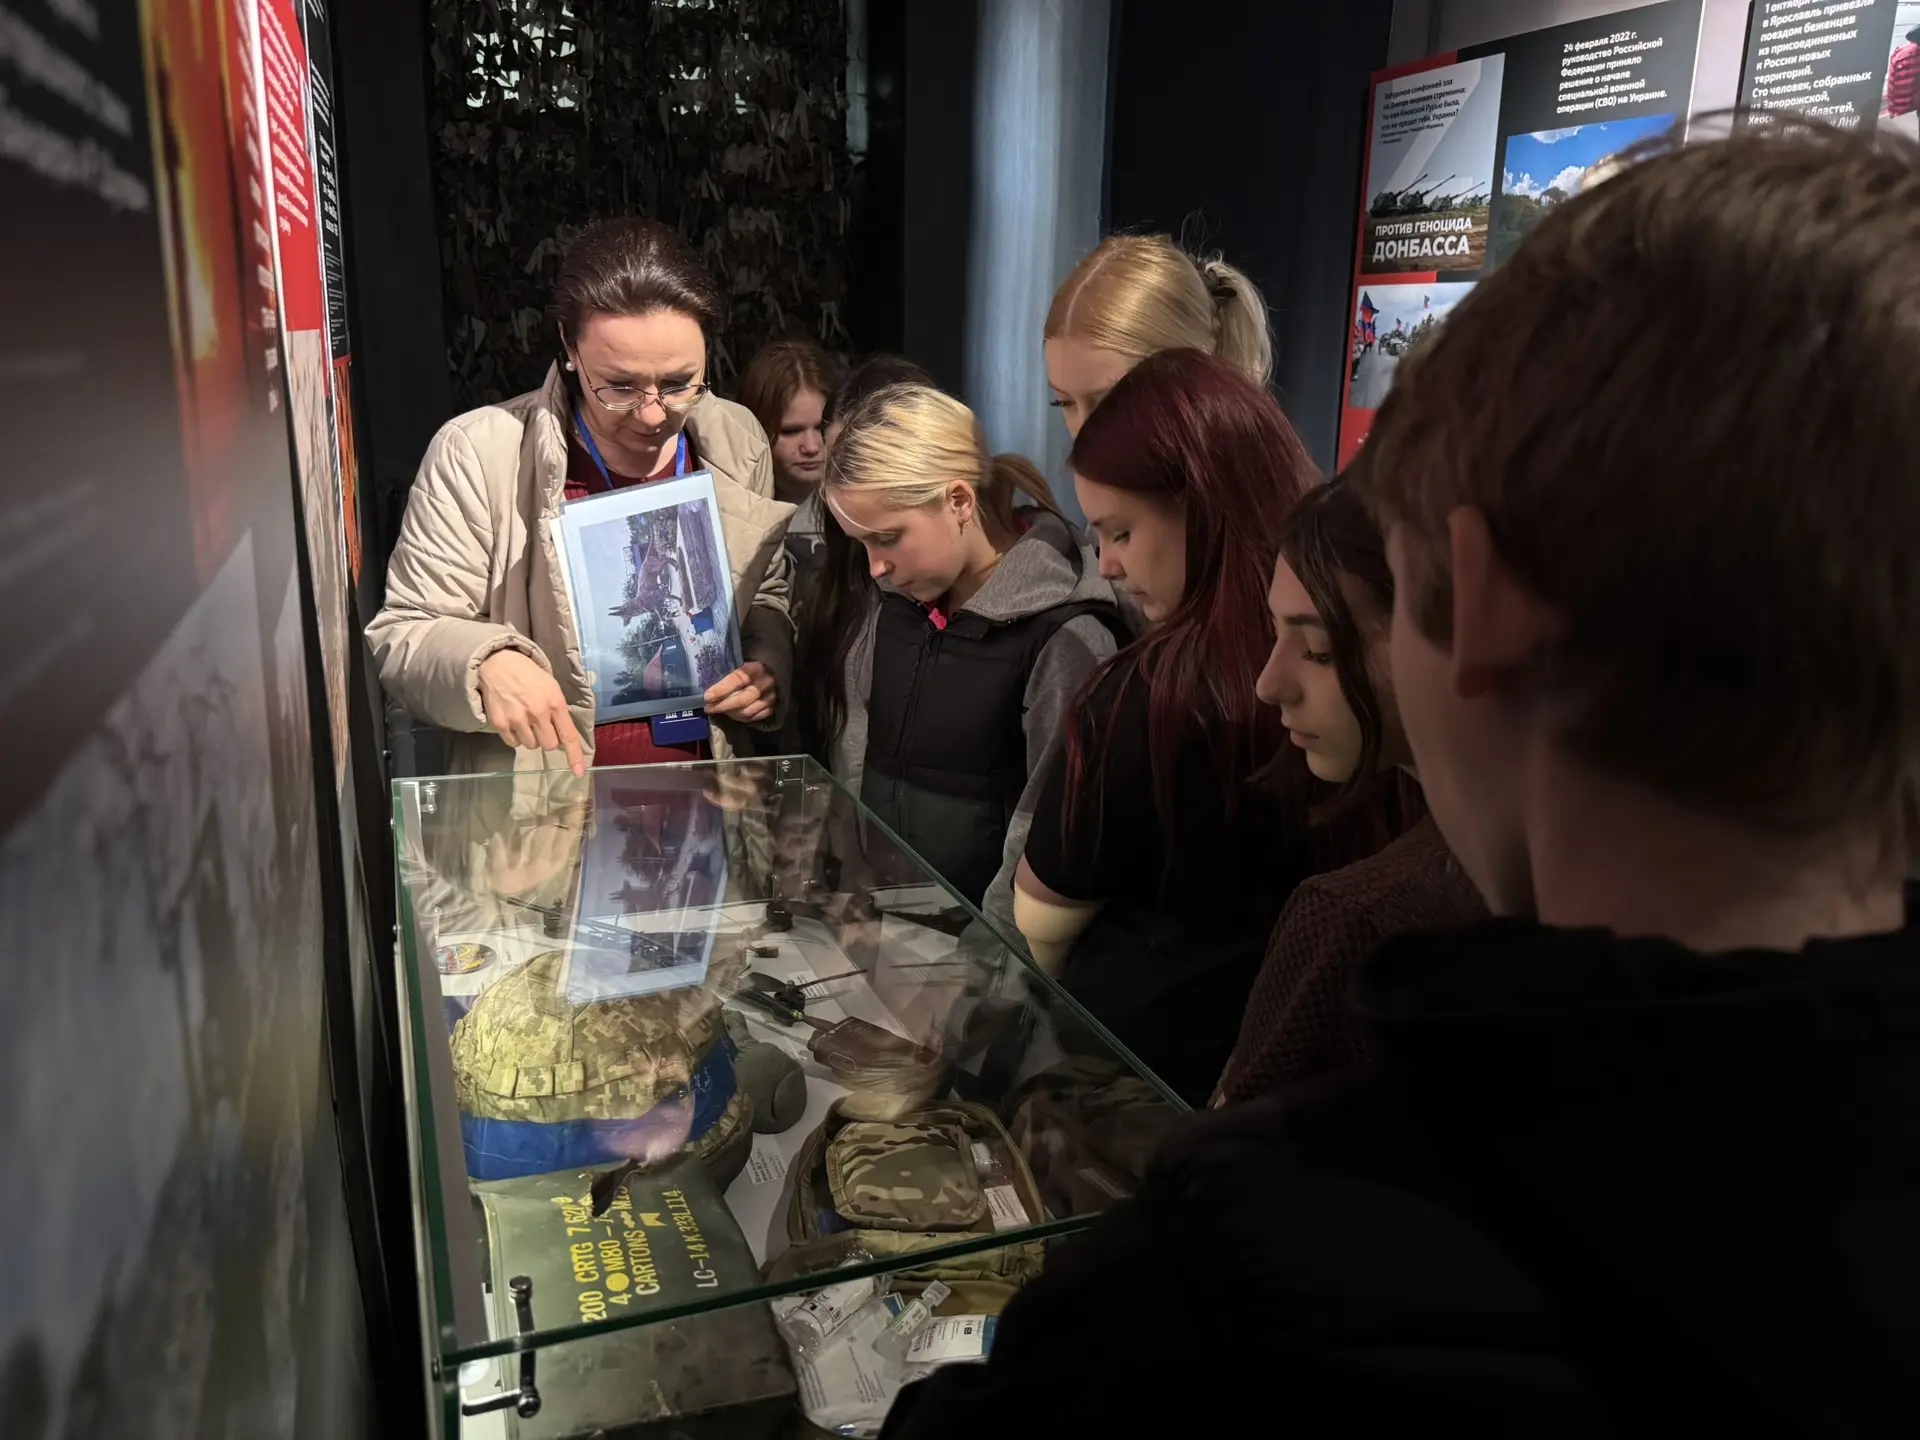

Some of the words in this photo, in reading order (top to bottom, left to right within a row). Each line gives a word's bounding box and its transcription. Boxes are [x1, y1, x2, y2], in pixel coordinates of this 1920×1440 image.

[1765, 4, 1770, 13] 1
[1769, 8, 1822, 29] Ярославль
[1760, 28, 1803, 42] поездом
[1803, 14, 1856, 33] беженцев
[1562, 50, 1612, 67] руководство
[1613, 38, 1663, 55] Российской
[1563, 44, 1574, 53] 24
[1574, 37, 1609, 52] февраля
[1609, 31, 1630, 43] 2022
[1631, 32, 1638, 40] г.
[1758, 47, 1770, 56] из
[1770, 29, 1858, 54] присоединенных
[1561, 62, 1606, 77] Федерации
[1606, 56, 1642, 69] приняло
[1756, 62, 1763, 70] к
[1763, 55, 1797, 69] России
[1798, 49, 1831, 62] новых
[1559, 76, 1594, 91] решение
[1595, 75, 1600, 83] о
[1601, 70, 1631, 82] начале
[1752, 86, 1768, 98] Сто
[1769, 80, 1811, 96] человек,
[1813, 70, 1872, 88] собранных
[1754, 66, 1813, 85] территорий.
[1556, 102, 1594, 114] операции
[1595, 96, 1617, 109] (СВО)
[1618, 95, 1628, 104] на
[1629, 89, 1668, 103] Украине.
[1558, 85, 1609, 102] специальной
[1610, 79, 1646, 93] военной
[1763, 90, 1830, 110] Запорожской,
[1805, 101, 1855, 117] областей,
[1375, 222, 1413, 236] ПРОТИВ
[1414, 216, 1473, 233] ГЕНОЦИДА
[1372, 235, 1470, 263] ДОНБАССА
[569, 1240, 601, 1284] CRTG
[598, 1240, 627, 1272] M80
[624, 1229, 661, 1296] CARTONS
[578, 1289, 608, 1324] 200
